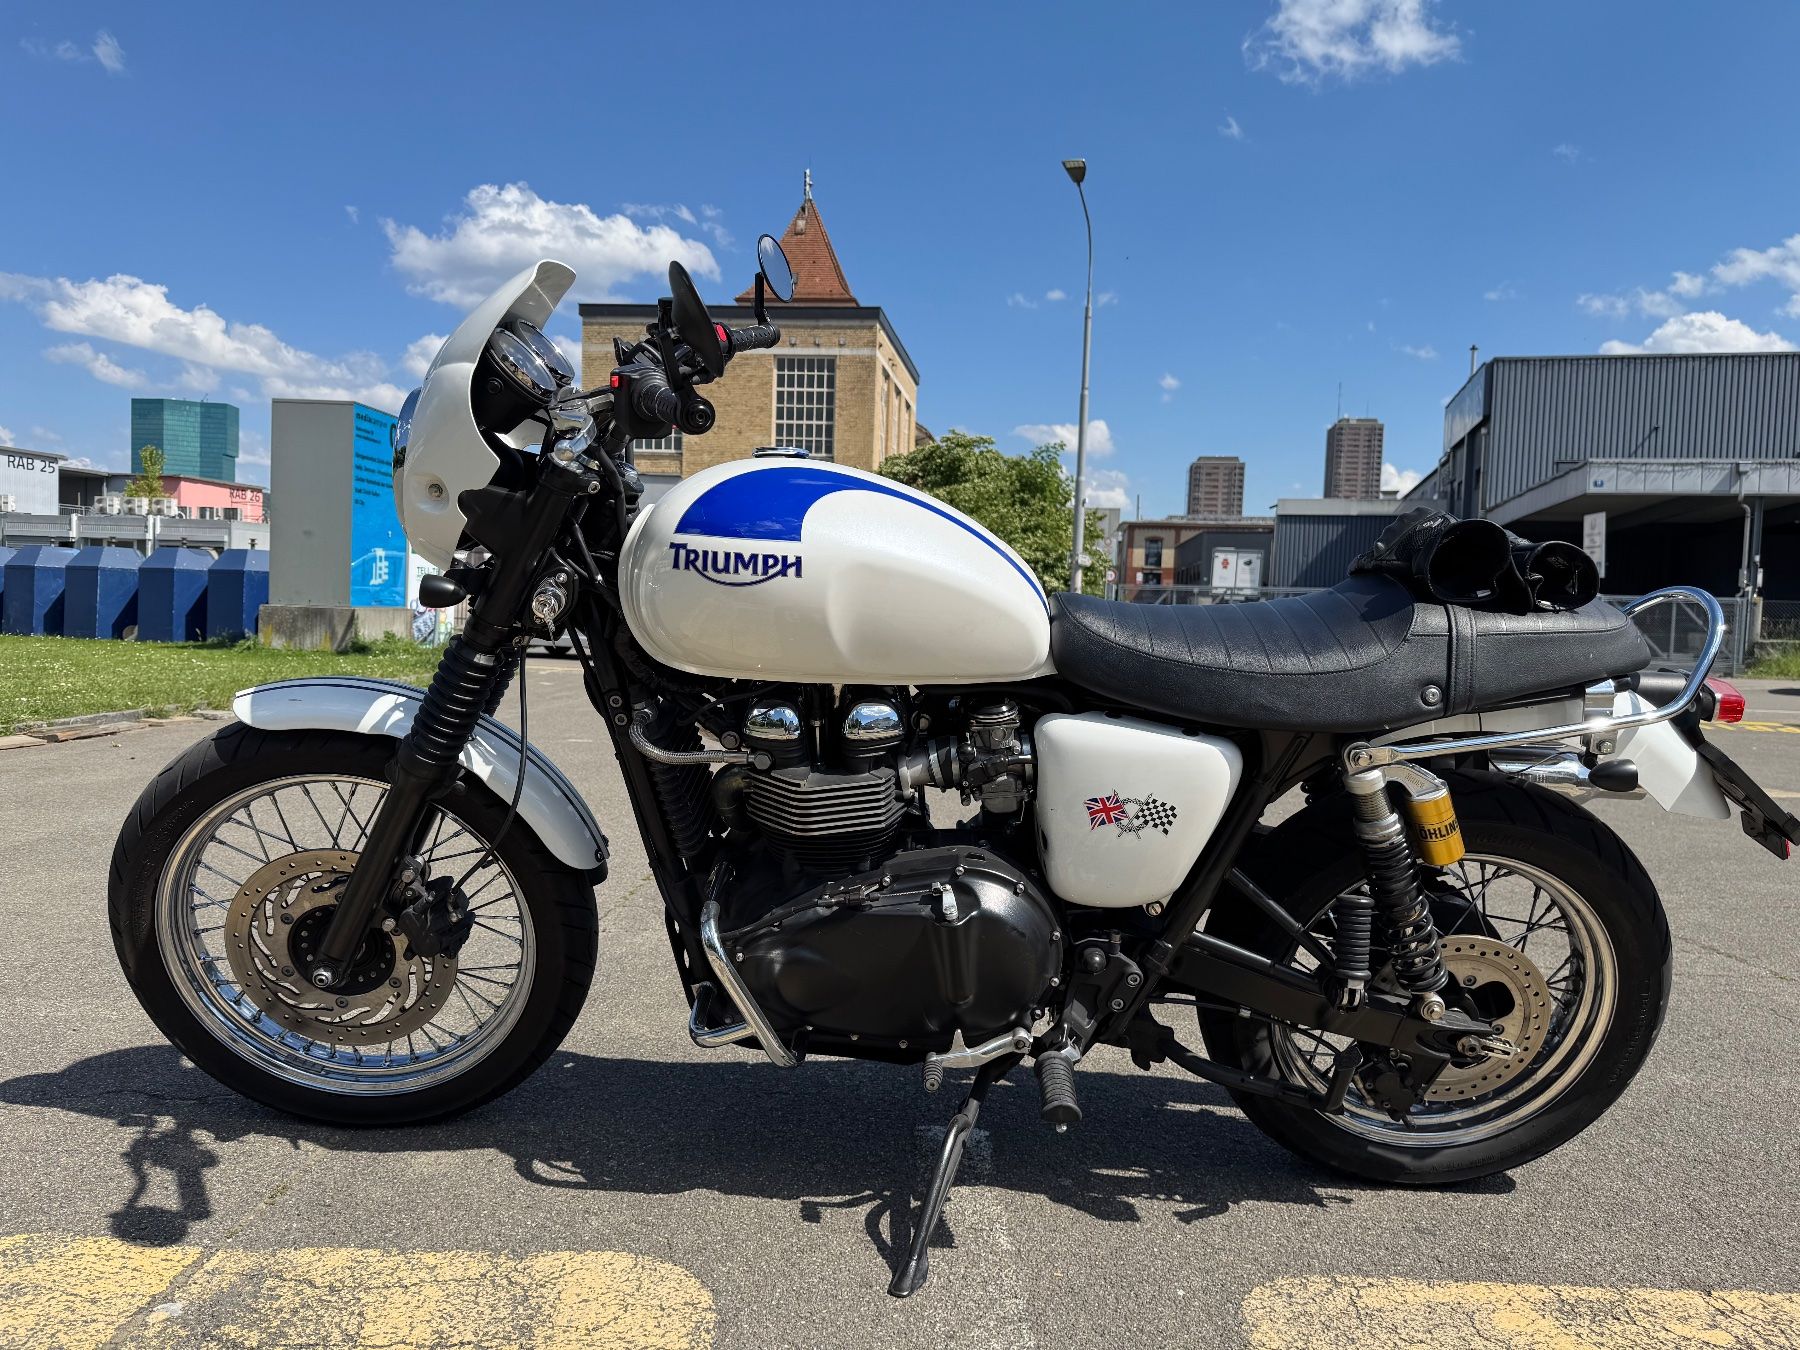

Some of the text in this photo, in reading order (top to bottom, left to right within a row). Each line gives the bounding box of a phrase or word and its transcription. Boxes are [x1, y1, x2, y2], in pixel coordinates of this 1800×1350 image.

[7, 455, 56, 473] RAB 25
[230, 487, 261, 502] RAB 26
[669, 542, 803, 587] TRIUMPH
